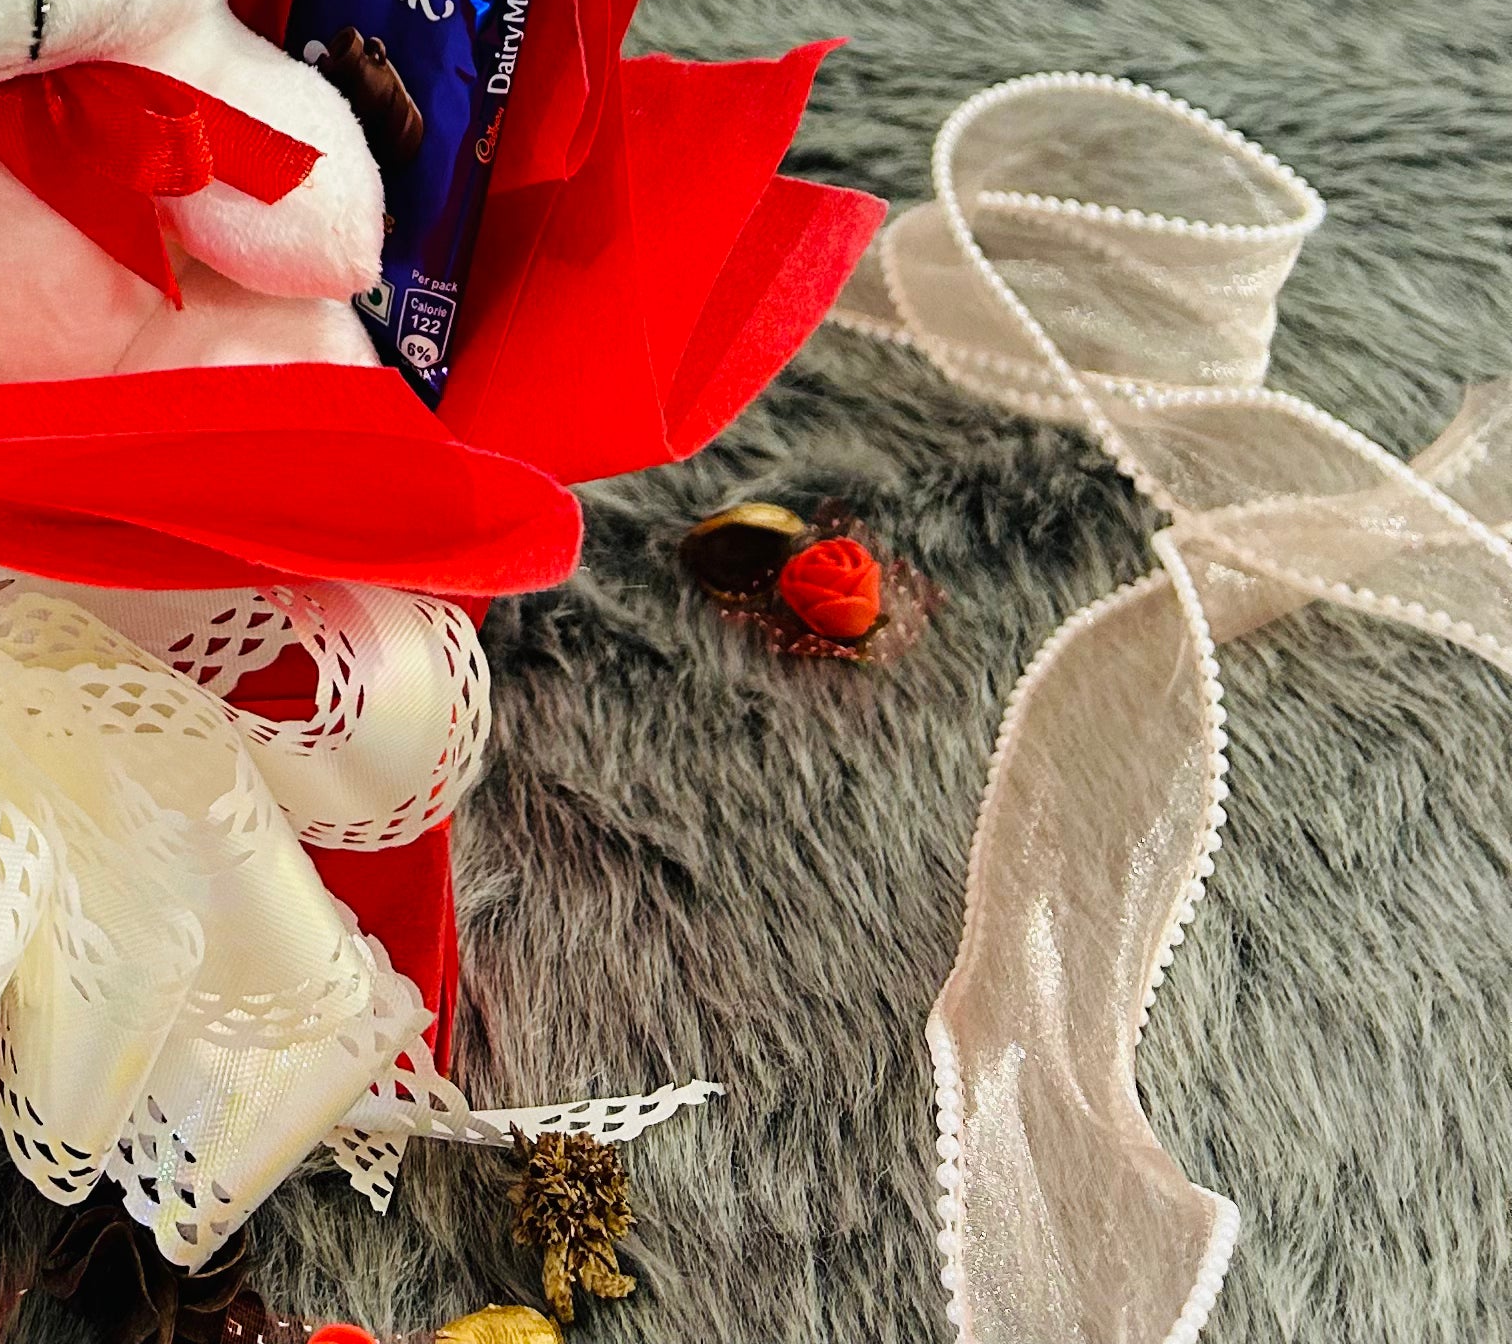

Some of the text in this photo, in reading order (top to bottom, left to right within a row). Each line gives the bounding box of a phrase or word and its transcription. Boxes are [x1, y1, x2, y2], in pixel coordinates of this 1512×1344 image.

[486, 24, 525, 95] Dairy
[411, 268, 458, 293] Per pack
[410, 297, 448, 318] Calorie
[411, 314, 442, 335] 122
[407, 341, 432, 363] 6%
